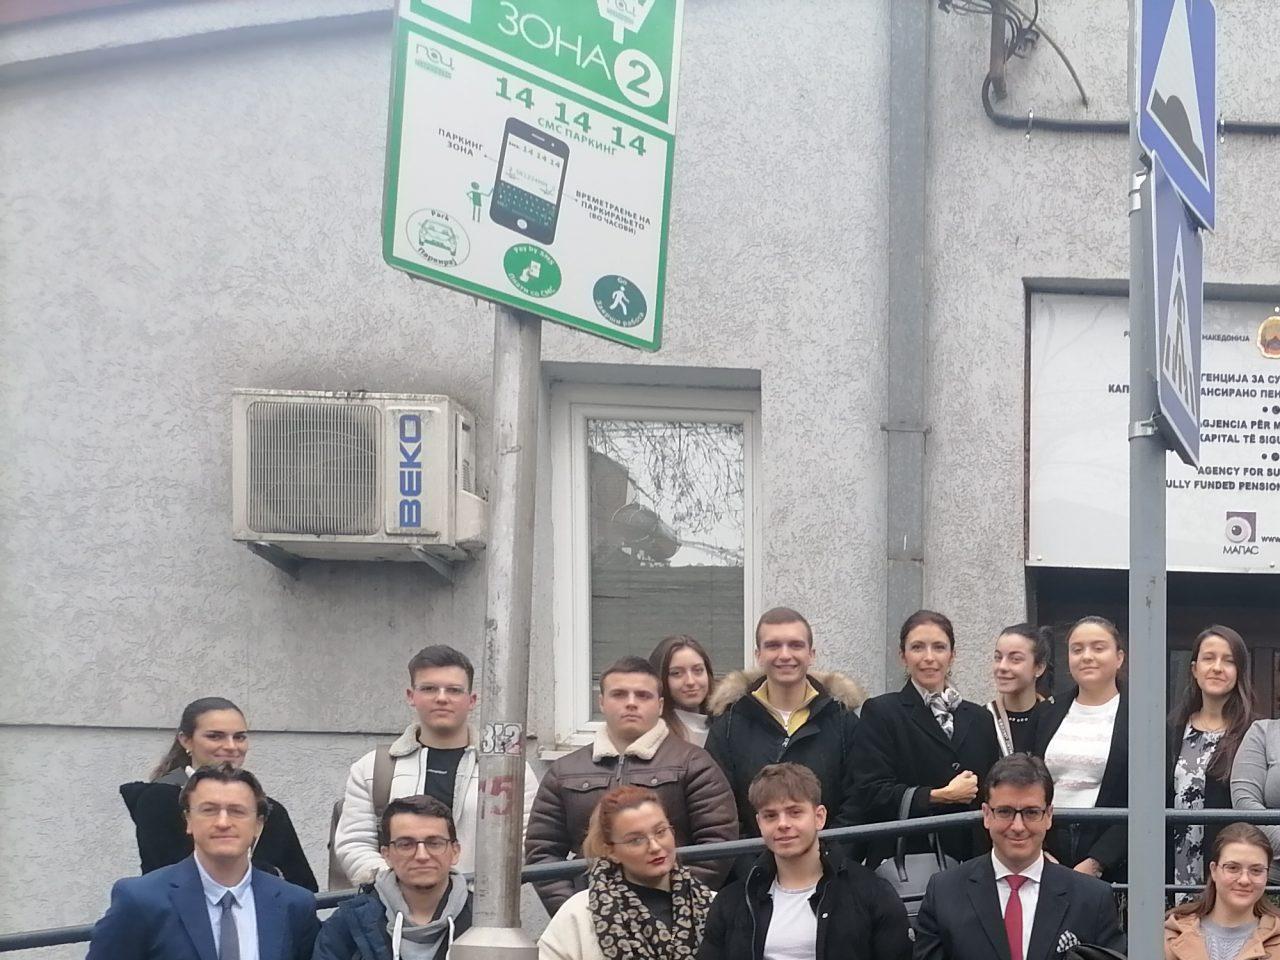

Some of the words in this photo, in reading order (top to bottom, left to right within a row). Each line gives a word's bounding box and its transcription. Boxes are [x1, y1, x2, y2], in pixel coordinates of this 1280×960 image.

[498, 2, 612, 80] ЗОНА
[626, 59, 652, 98] 2
[496, 76, 535, 110] 14
[554, 102, 592, 133] 14
[611, 126, 647, 157] 14
[438, 128, 484, 151] ПАРКИНГ
[538, 117, 563, 135] СМС
[565, 129, 618, 156] ПАРКИНГ
[448, 141, 474, 157] ЗОНА
[639, 215, 651, 225] НА
[1201, 373, 1249, 384] ГЕНЦИЈА
[1251, 374, 1265, 384] ЗА
[1201, 388, 1257, 398] АНСИРАНО
[1200, 419, 1248, 429] GJENCIA
[1251, 419, 1271, 430] PËR
[1243, 433, 1256, 443] TË
[400, 414, 422, 528] BEKO
[1198, 466, 1241, 475] AGENCY
[1243, 467, 1264, 476] FOR
[1166, 480, 1191, 488] ULLY
[1194, 480, 1236, 490] FUNDED
[1223, 546, 1260, 555] МАПАС
